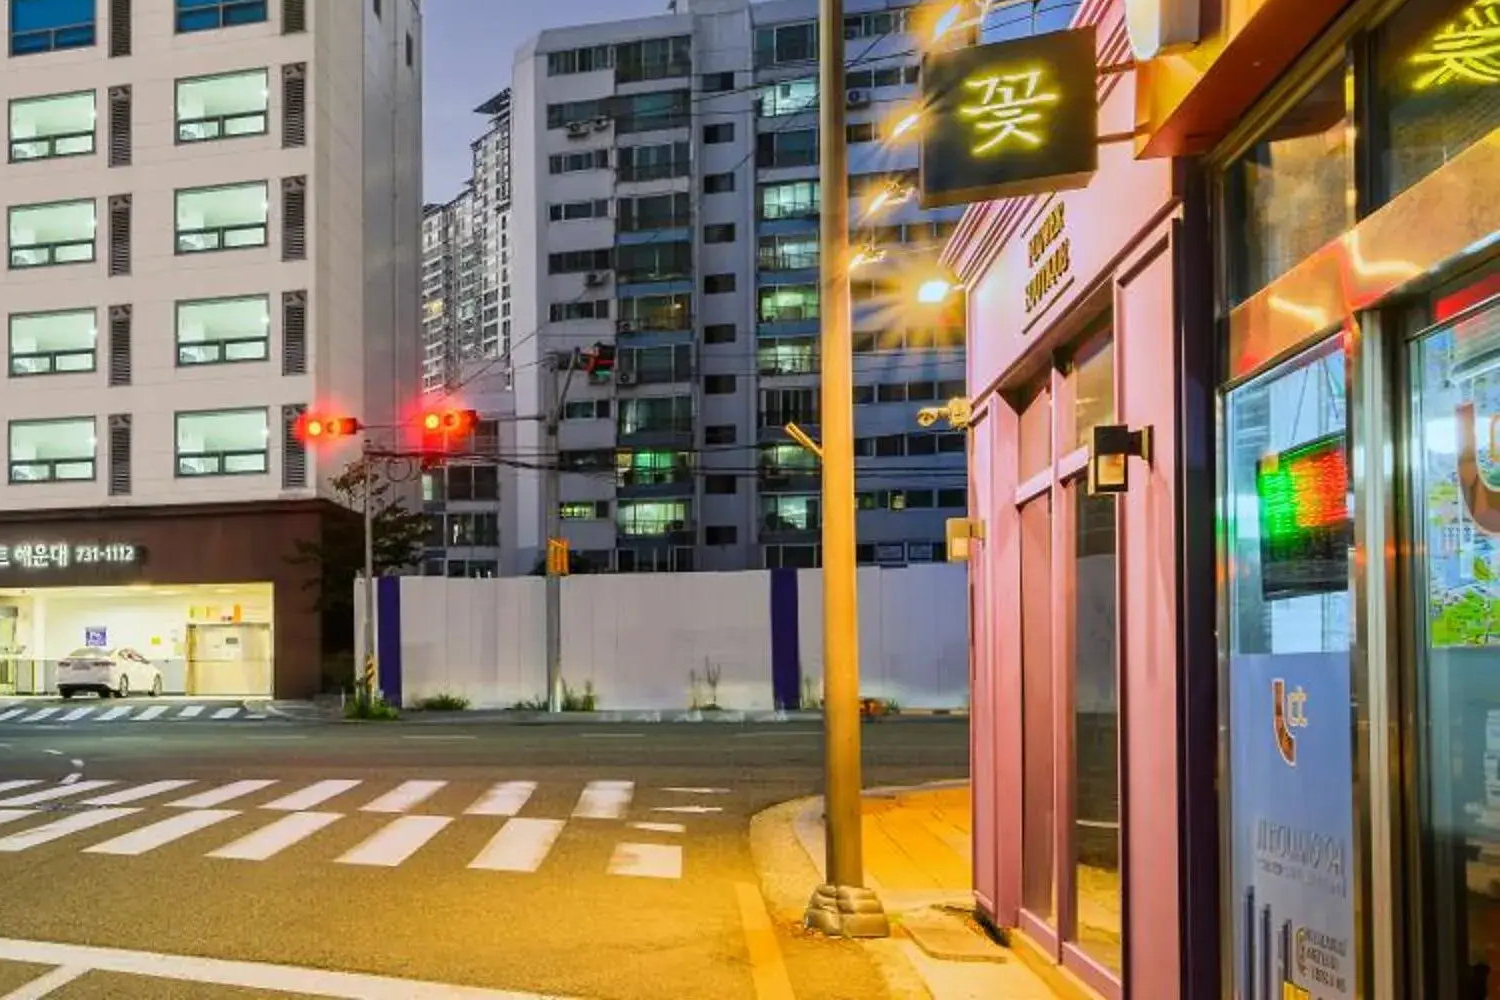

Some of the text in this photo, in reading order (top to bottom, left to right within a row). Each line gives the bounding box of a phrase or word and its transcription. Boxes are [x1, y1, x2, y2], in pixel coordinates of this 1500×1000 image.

[960, 67, 1058, 156] 꽃
[14, 544, 68, 568] 해운대
[75, 545, 135, 563] 731-1112
